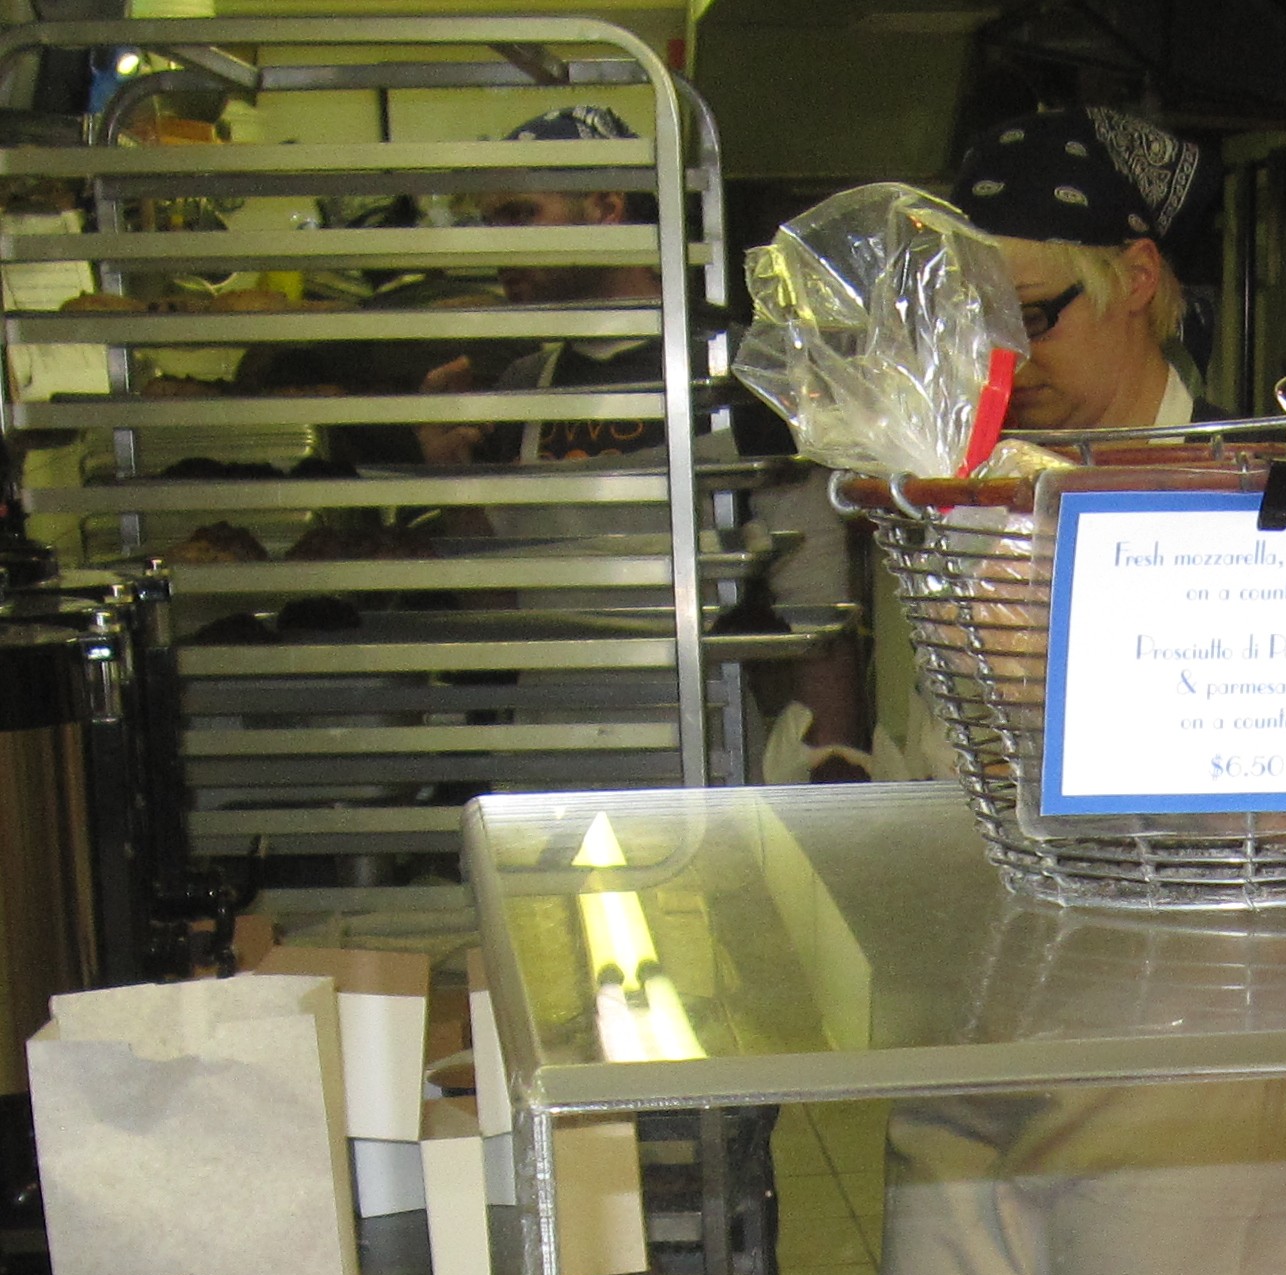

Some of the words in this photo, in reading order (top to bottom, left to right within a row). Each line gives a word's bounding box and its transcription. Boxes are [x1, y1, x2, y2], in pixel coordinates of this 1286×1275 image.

[1114, 541, 1164, 567] Fresh
[1174, 540, 1285, 568] mozzarella,
[1186, 585, 1210, 601] on
[1219, 586, 1231, 601] a
[1135, 634, 1233, 661] Prosciutto
[1242, 634, 1260, 660] di
[1176, 669, 1198, 695] &
[1180, 713, 1204, 730] on
[1213, 714, 1224, 730] a
[1210, 754, 1285, 781] $6.50
